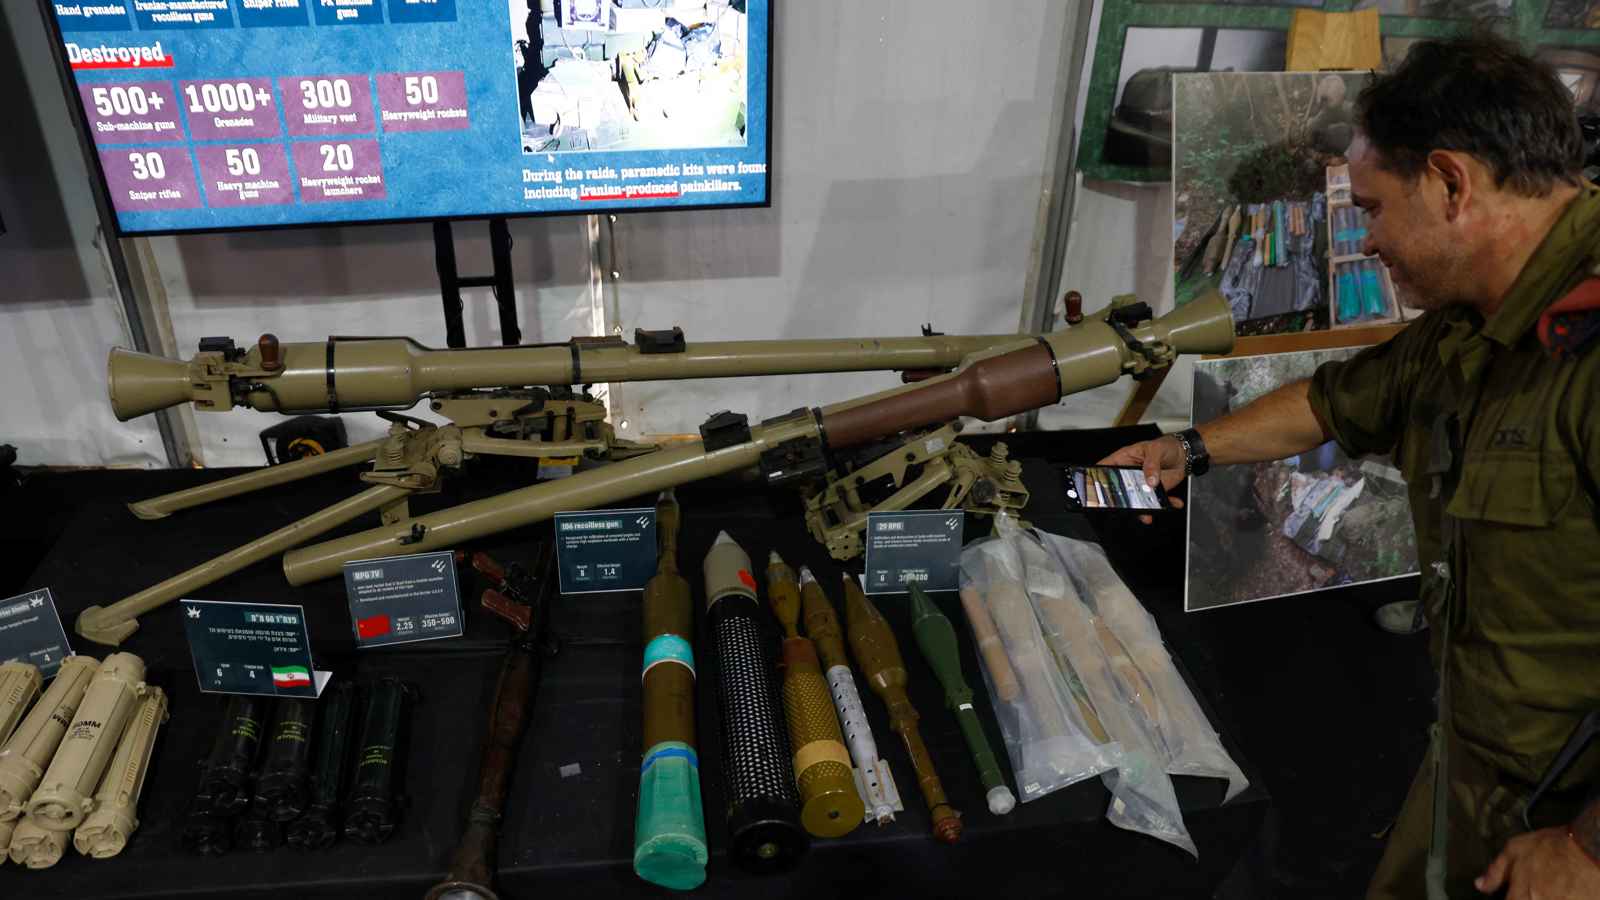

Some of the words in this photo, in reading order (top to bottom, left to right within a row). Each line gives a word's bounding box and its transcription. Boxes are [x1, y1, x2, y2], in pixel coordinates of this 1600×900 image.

[55, 4, 82, 15] Hand
[82, 4, 126, 17] grenades
[151, 11, 193, 22] recoilless
[193, 12, 214, 23] guns
[336, 8, 359, 20] guns
[64, 41, 166, 66] Destroyed
[300, 78, 352, 109] 300
[404, 75, 440, 105] 50
[92, 86, 165, 117] 500+
[184, 82, 271, 113] 1000+
[303, 113, 338, 125] Military
[338, 112, 358, 123] vest
[381, 108, 435, 121] Heavyweight
[436, 107, 468, 119] rockets
[96, 120, 154, 132] Sub-machine
[154, 121, 176, 132] guns
[213, 116, 255, 128] Grenades
[225, 147, 261, 177] 50
[319, 143, 354, 172] 20
[128, 151, 166, 180] 30
[522, 168, 563, 184] During
[564, 167, 584, 181] the
[585, 166, 618, 180] raids,
[620, 163, 681, 180] paramedic
[682, 163, 704, 176] kits
[706, 164, 736, 175] were
[216, 181, 243, 193] Heavy
[244, 179, 280, 190] machine
[300, 175, 354, 189] Heavyweight
[354, 174, 381, 185] rocket
[128, 190, 157, 201] Sniper
[158, 189, 182, 199] rifles
[239, 190, 260, 201] guns
[523, 182, 577, 201] including
[580, 178, 678, 196] Iranian-produced
[679, 178, 742, 196] painkillers.
[396, 621, 414, 631] 2.25
